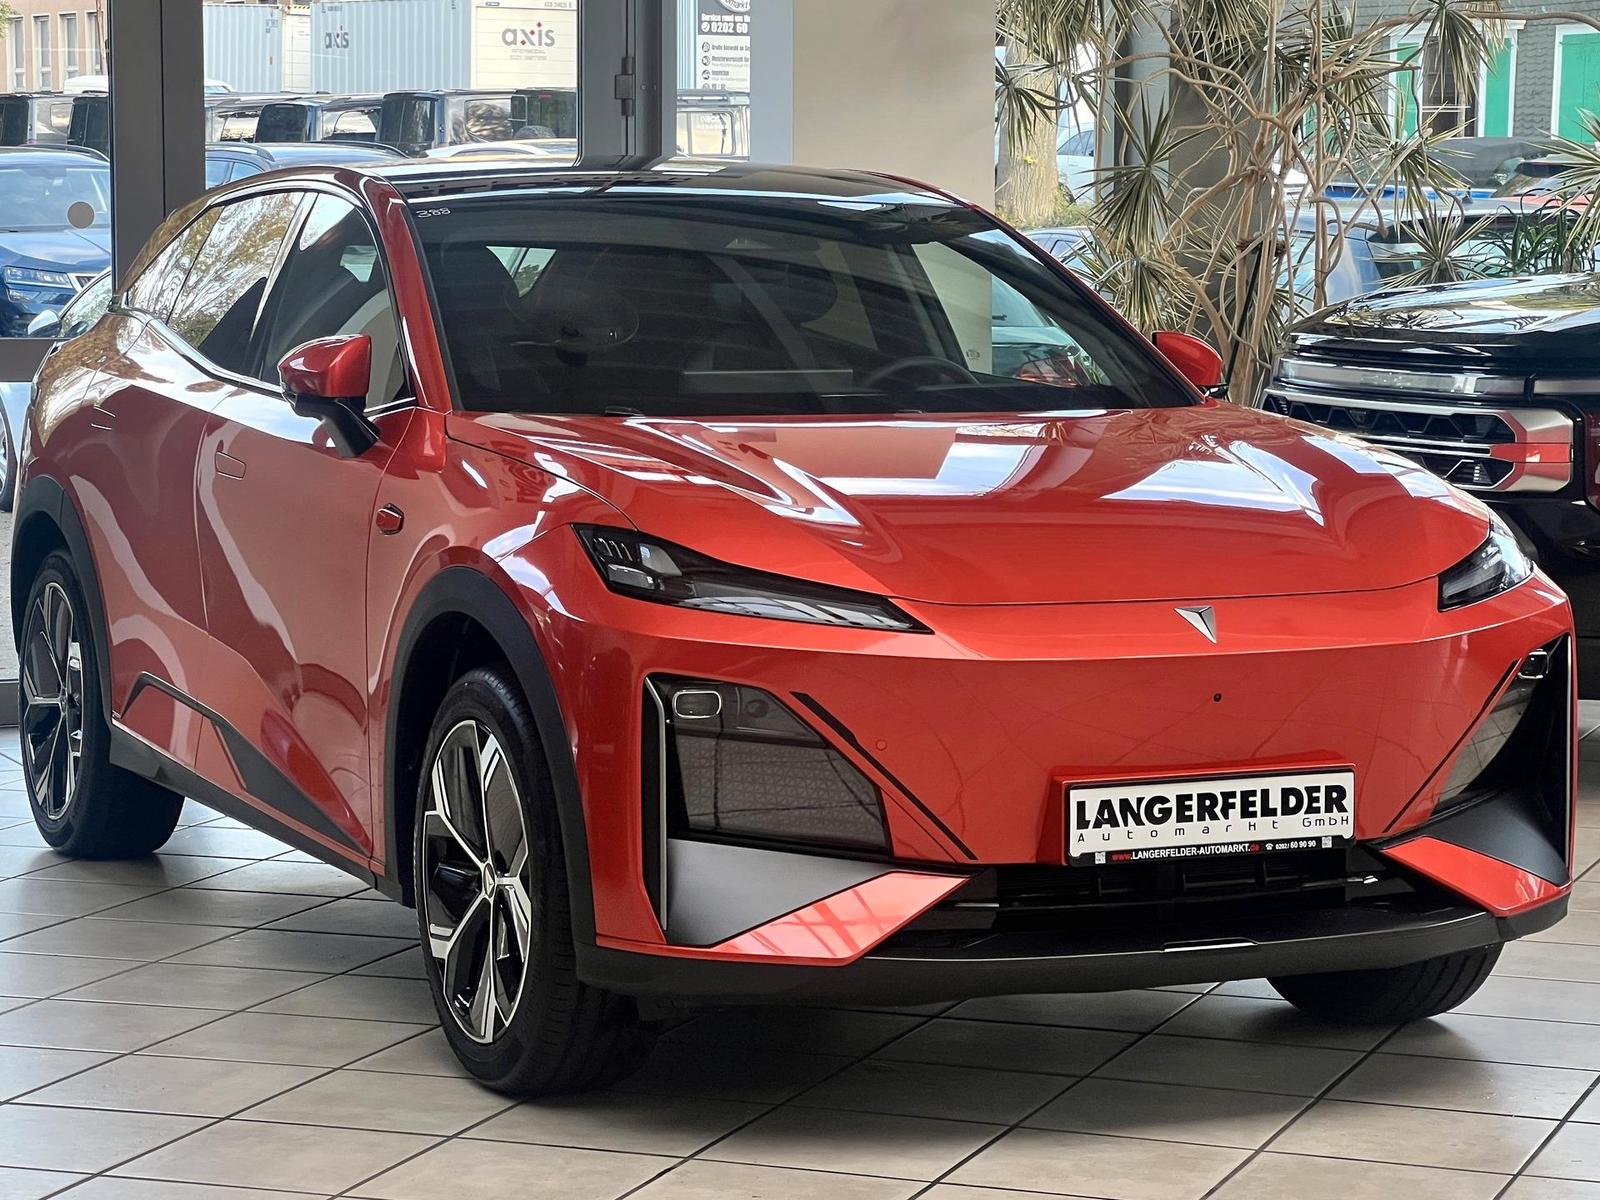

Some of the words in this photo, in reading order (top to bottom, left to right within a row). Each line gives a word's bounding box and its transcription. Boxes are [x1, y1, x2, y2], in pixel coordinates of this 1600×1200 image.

[324, 25, 350, 49] axis
[501, 22, 555, 47] axis
[711, 22, 734, 32] 0202
[736, 23, 748, 34] 60
[1076, 784, 1349, 830] LANGERFELDER
[1302, 815, 1350, 828] GmbH
